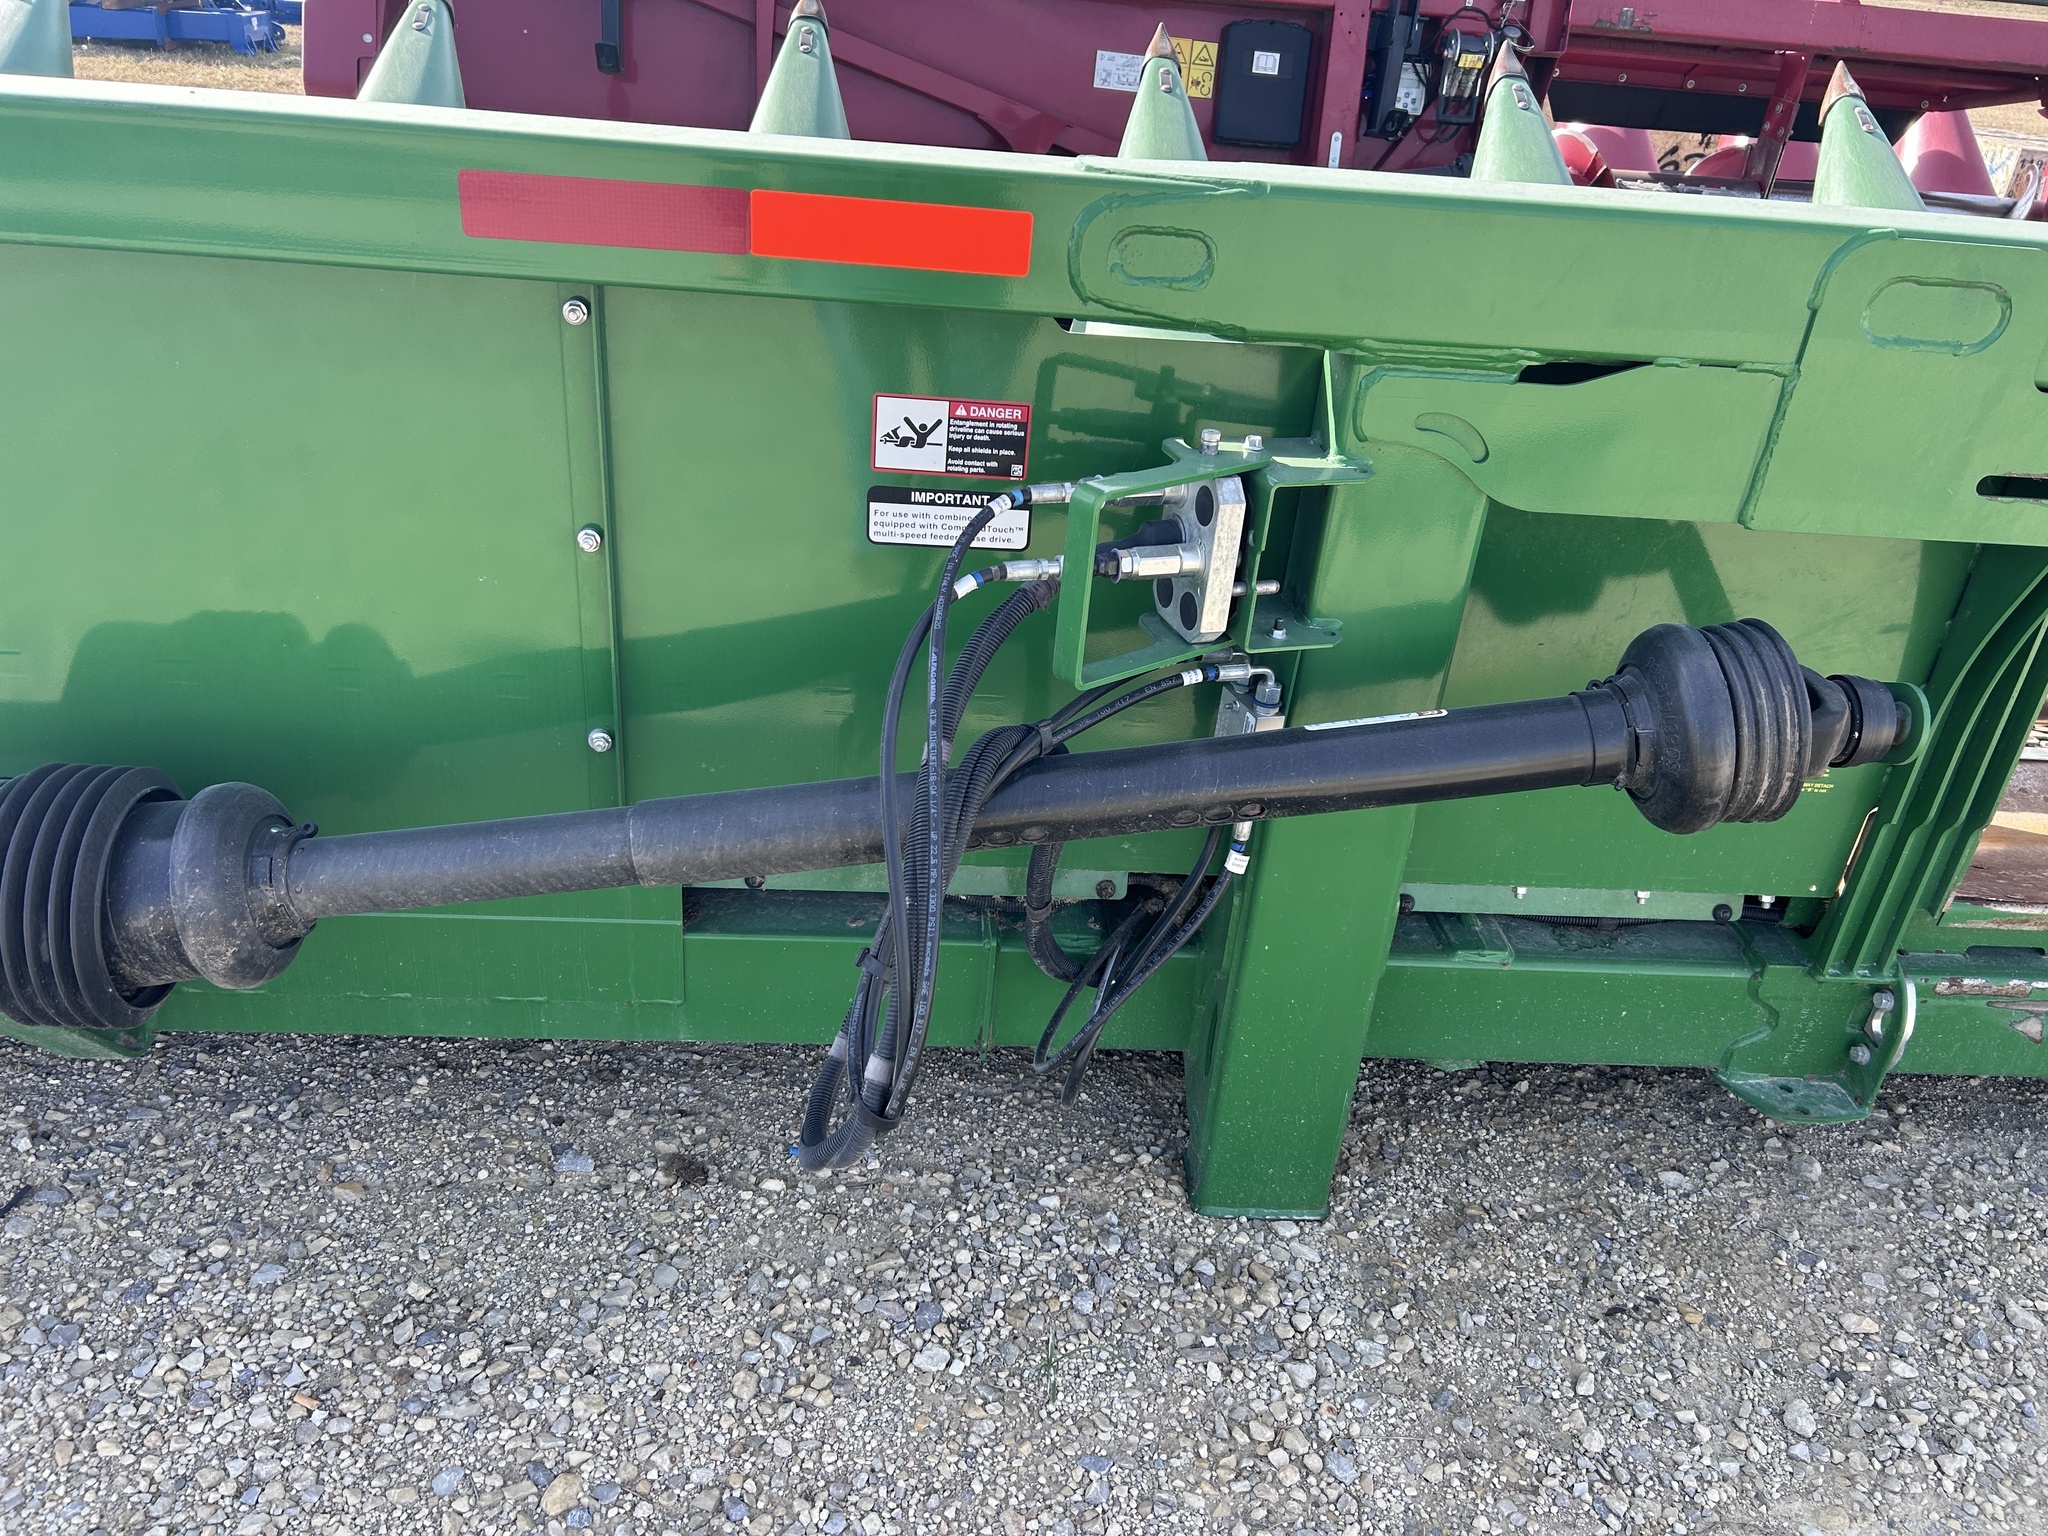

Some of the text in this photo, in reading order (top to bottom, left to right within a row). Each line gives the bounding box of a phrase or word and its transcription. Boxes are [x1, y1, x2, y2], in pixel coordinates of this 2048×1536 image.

[970, 406, 1022, 419] DANGER
[950, 419, 988, 428] Entanglement
[996, 422, 1018, 430] rotating
[911, 491, 990, 506] IMPORTANT
[912, 511, 930, 520] with
[934, 513, 973, 522] combine
[874, 521, 916, 530] equipped
[919, 522, 938, 530] with
[874, 530, 927, 540] multi-speed
[989, 535, 1015, 544] drive.
[1144, 685, 1156, 693] EN
[922, 981, 930, 996] SAE
[919, 1001, 927, 1015] 100
[915, 1019, 924, 1035] R17
[910, 1047, 917, 1058] EN
